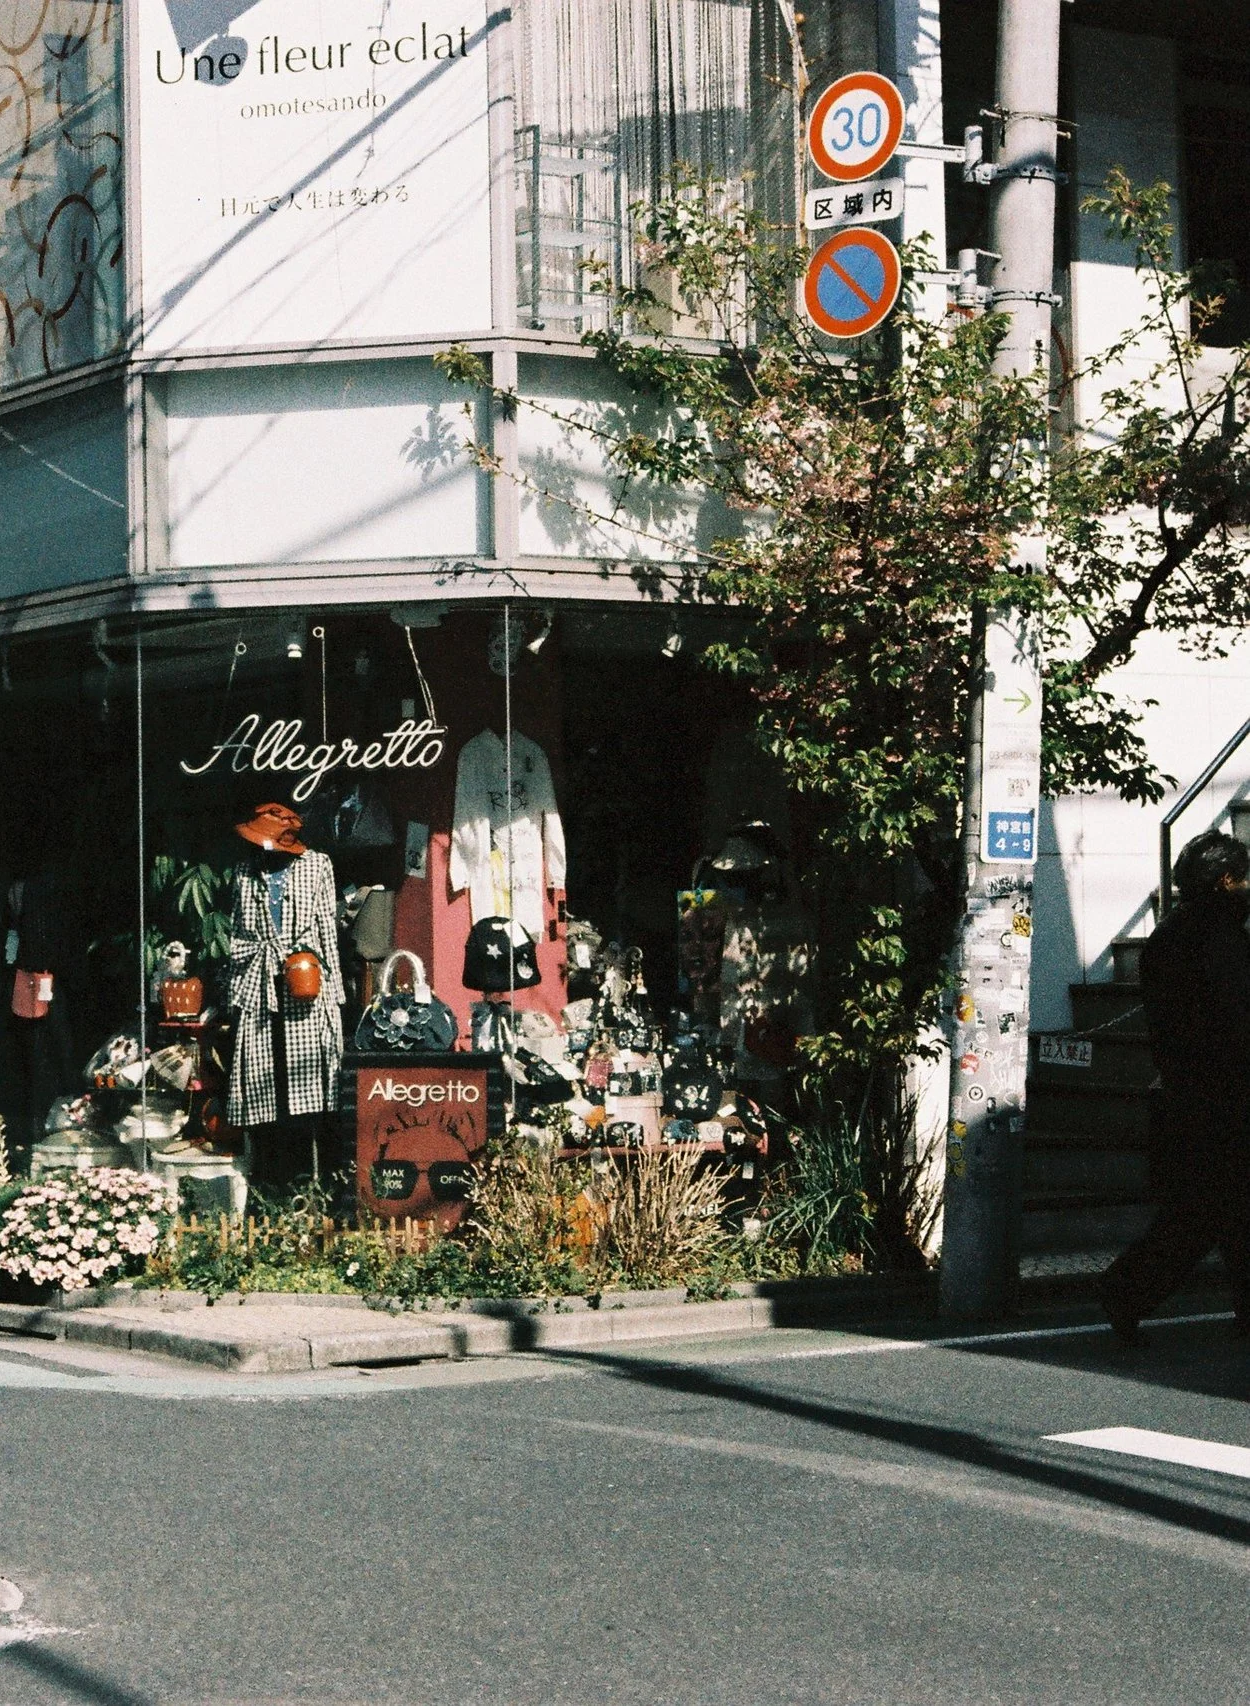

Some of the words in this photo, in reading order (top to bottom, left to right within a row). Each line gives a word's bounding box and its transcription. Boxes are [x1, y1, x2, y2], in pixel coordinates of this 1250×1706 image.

[156, 48, 242, 85] Une
[256, 33, 353, 76] fleur
[240, 88, 388, 121] omotesando
[831, 103, 882, 152] 30
[814, 188, 892, 220] 区域内
[180, 714, 447, 803] Allegretto
[368, 1079, 480, 1107] Allegretto
[382, 1169, 405, 1179] MAX
